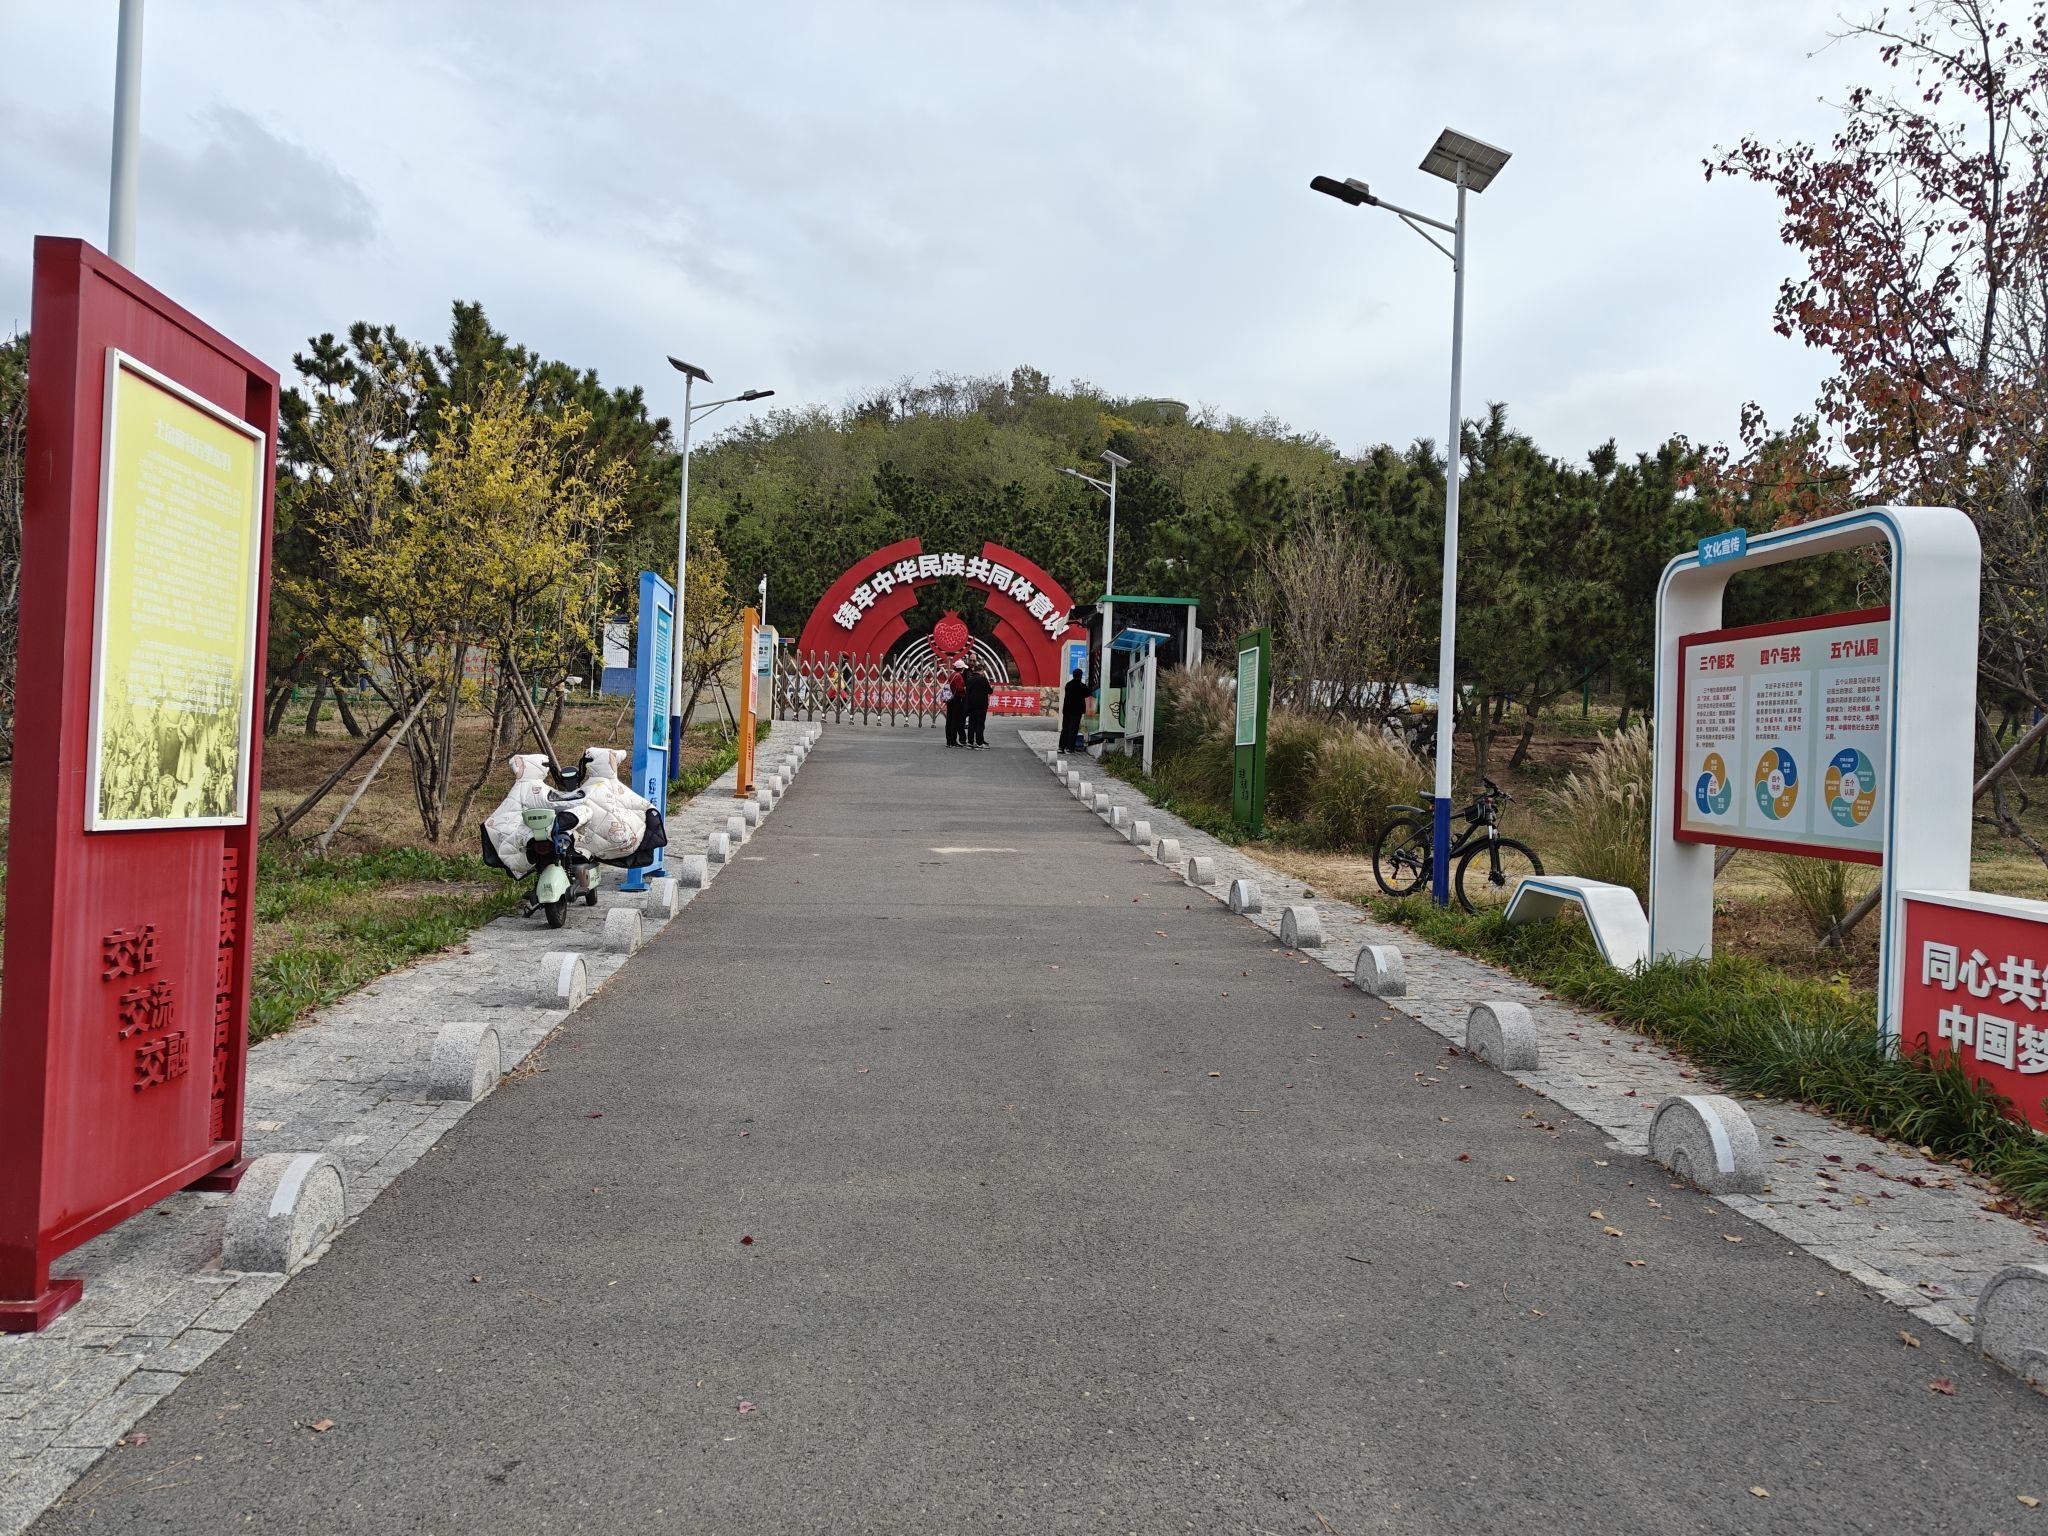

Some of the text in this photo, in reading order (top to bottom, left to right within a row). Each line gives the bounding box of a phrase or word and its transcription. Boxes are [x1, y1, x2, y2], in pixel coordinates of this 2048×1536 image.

[1703, 538, 1740, 559] 文化宣传
[833, 553, 1070, 641] 铸牢中华民族共同体意识
[1700, 653, 1735, 671] 三个相交
[1760, 646, 1800, 665] 四个与共
[1830, 638, 1879, 660] 五个认同
[102, 923, 162, 983] 交往
[1922, 940, 2048, 1011] 同心共
[118, 980, 176, 1040] 交流
[1938, 1004, 2048, 1074] 中国梦
[133, 1030, 191, 1094] 交融
